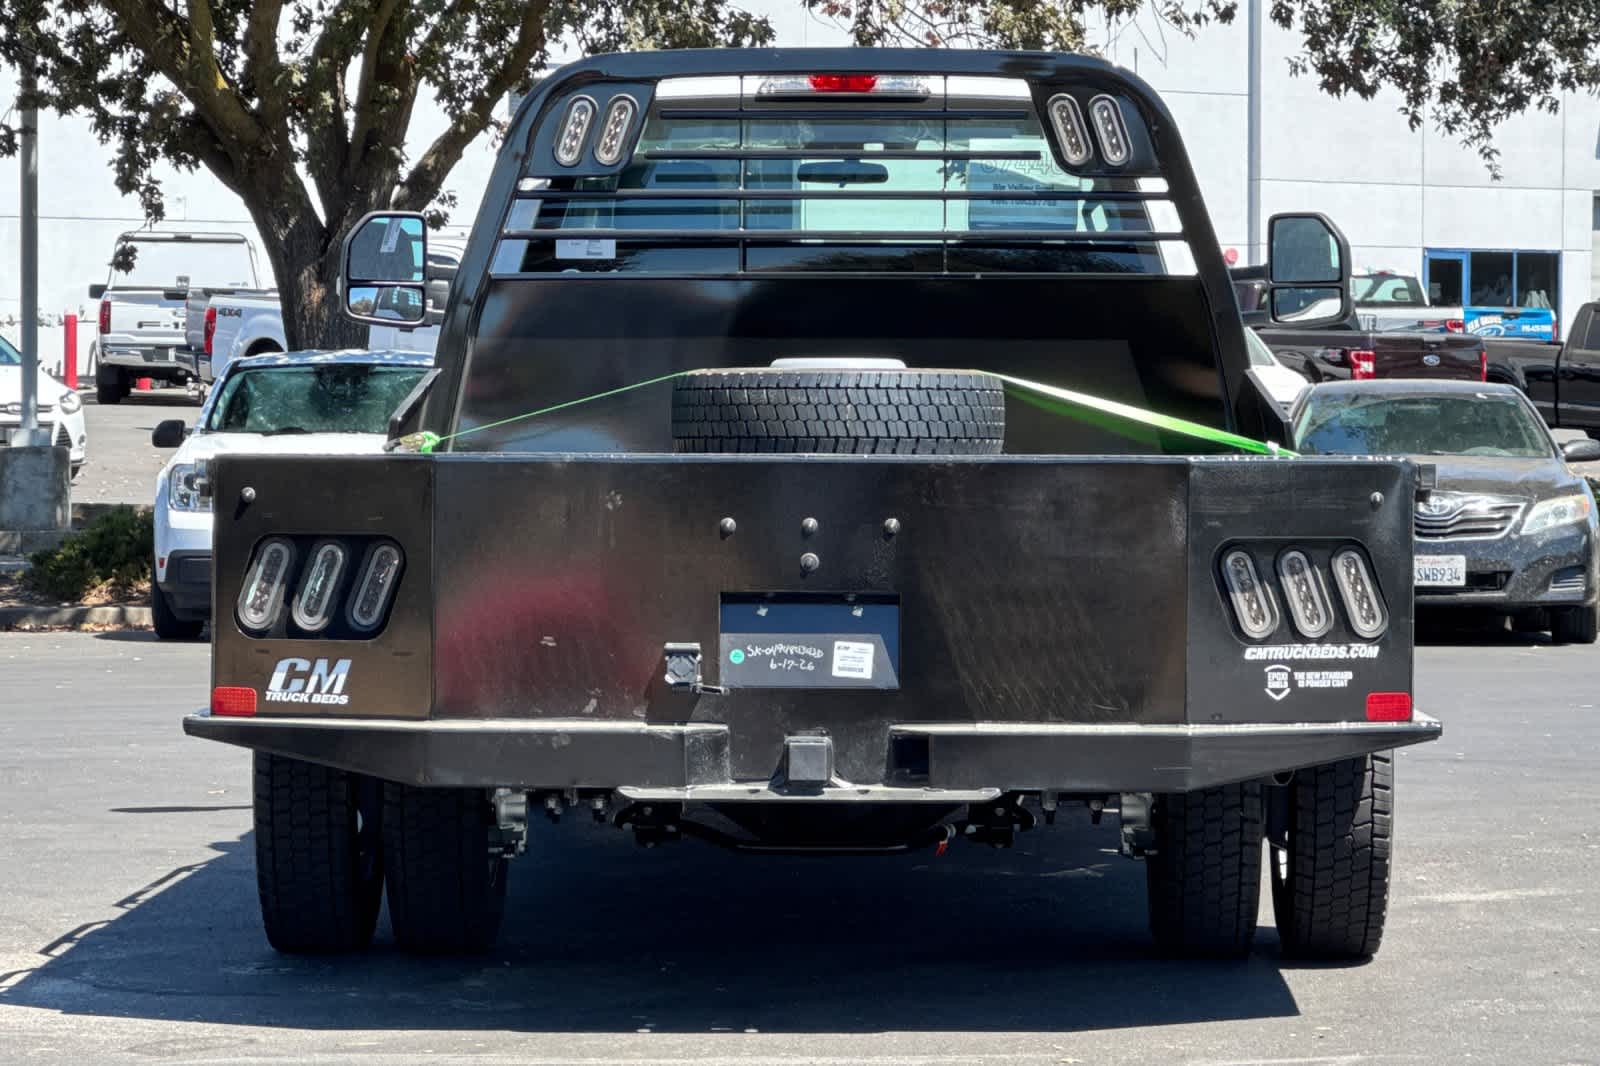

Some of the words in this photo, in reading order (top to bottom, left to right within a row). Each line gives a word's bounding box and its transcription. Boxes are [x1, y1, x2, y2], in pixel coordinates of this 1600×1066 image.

[1244, 645, 1380, 660] CMTRUCKBEDS.COM
[267, 657, 352, 694] CM
[265, 691, 310, 703] TRUCK
[311, 694, 349, 705] BEDS
